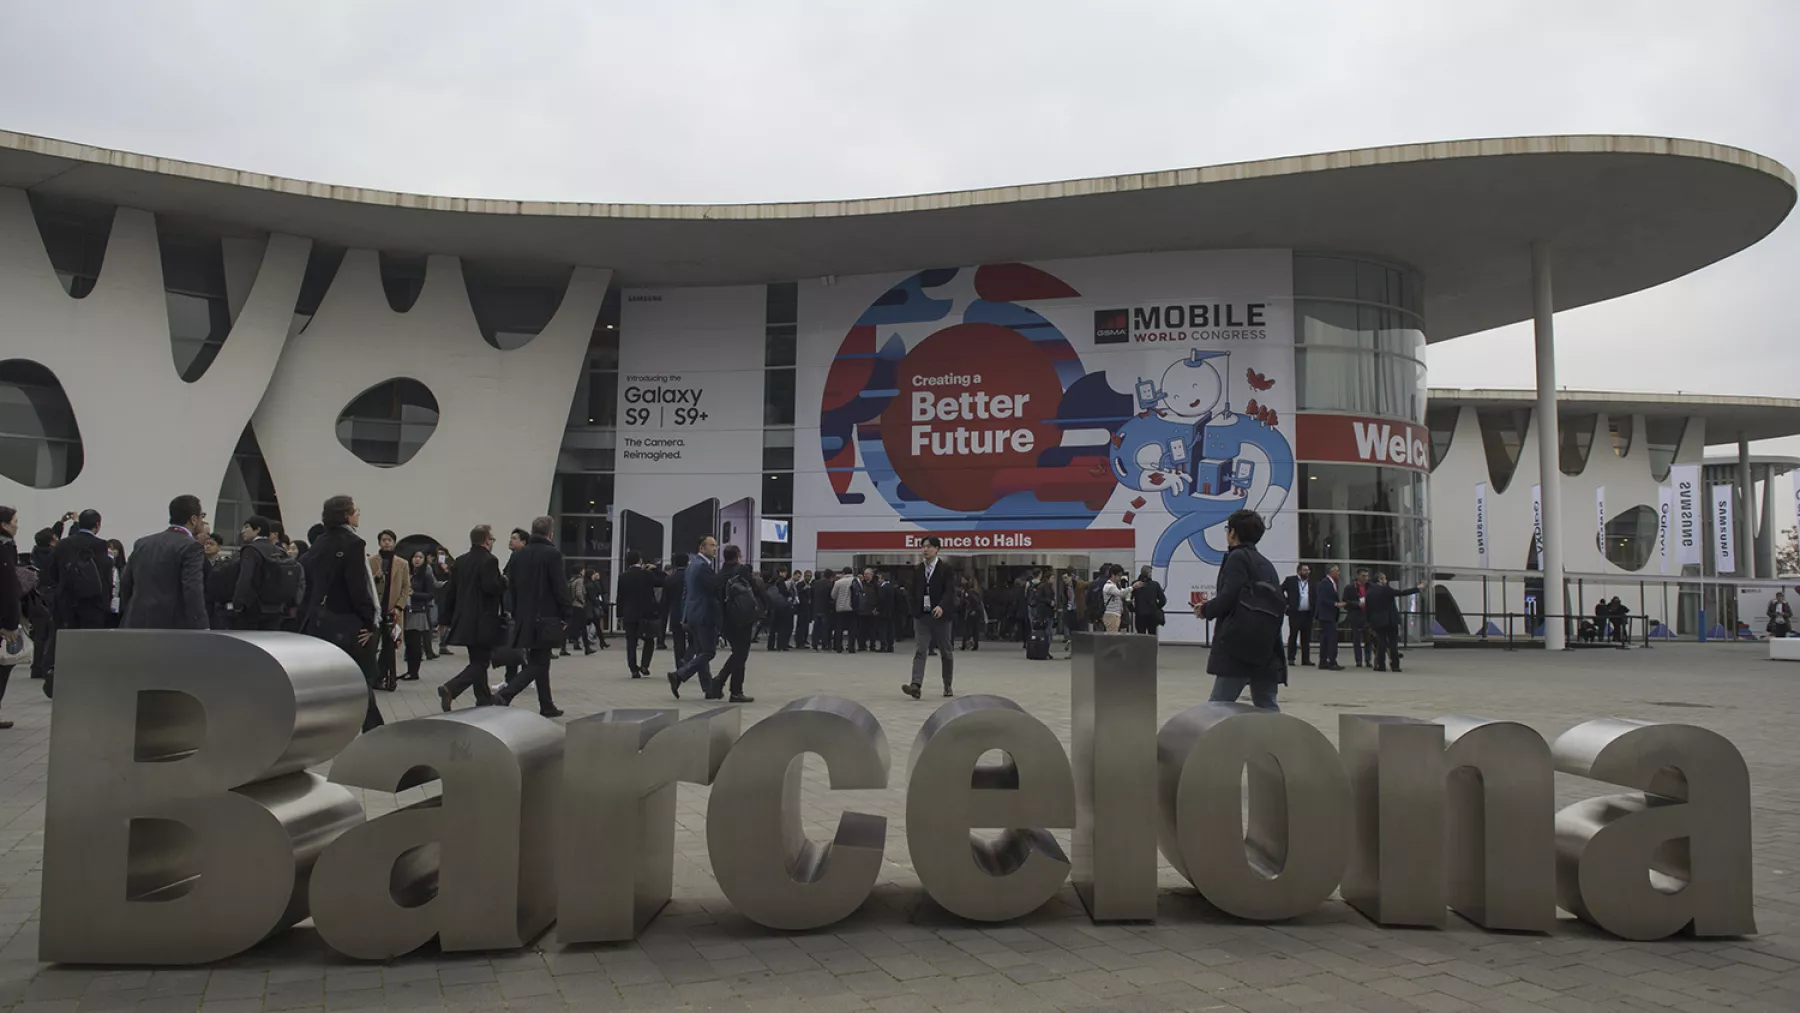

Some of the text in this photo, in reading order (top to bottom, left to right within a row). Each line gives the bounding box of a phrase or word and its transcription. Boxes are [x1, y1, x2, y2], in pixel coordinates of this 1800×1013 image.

[1134, 304, 1265, 330] MOBILE
[1096, 329, 1126, 337] GSMA
[1134, 330, 1267, 342] WORLD CONGRESS
[626, 375, 668, 383] Introducing
[912, 372, 982, 387] Creating a
[624, 386, 703, 407] Galaxy
[911, 391, 1031, 421] Better
[625, 407, 709, 426] S9 S9+
[624, 438, 686, 447] The Camera.
[911, 425, 1035, 456] Future
[623, 450, 682, 462] Reimagined.
[974, 535, 990, 547] to
[993, 533, 1032, 547] Halls
[38, 629, 1757, 966] Barcelona
